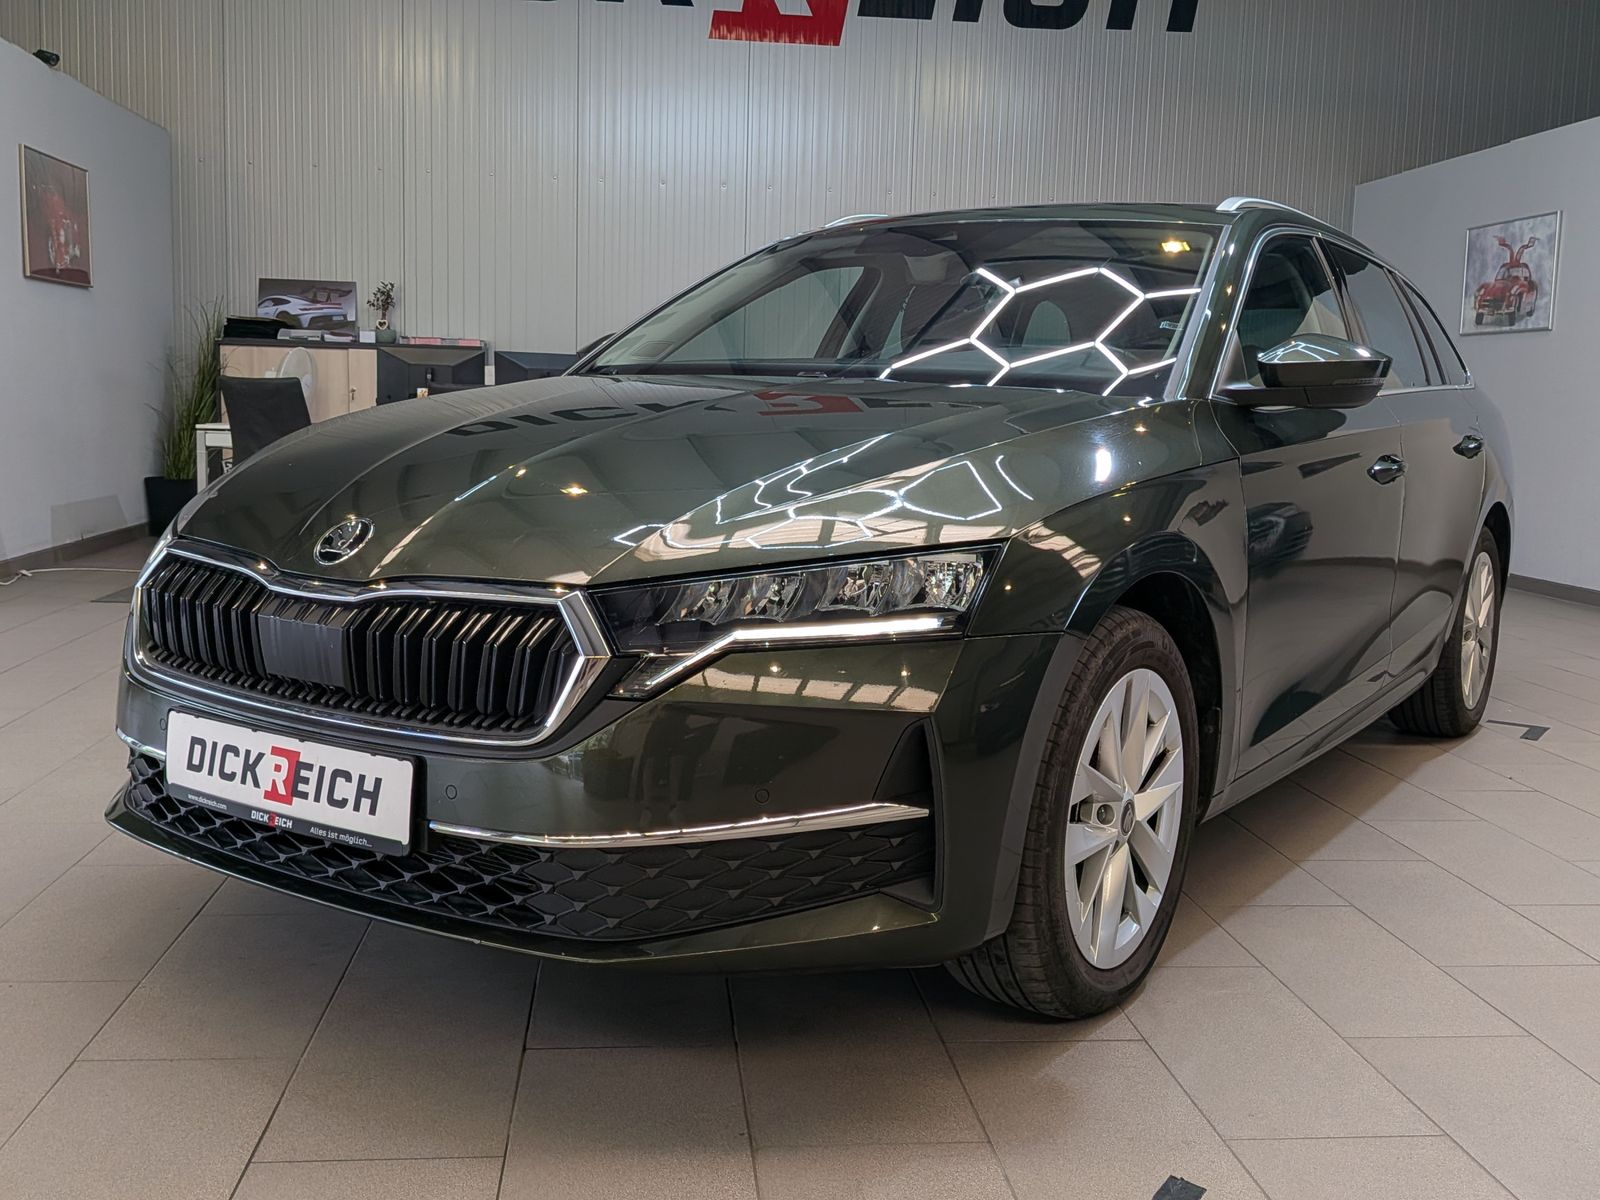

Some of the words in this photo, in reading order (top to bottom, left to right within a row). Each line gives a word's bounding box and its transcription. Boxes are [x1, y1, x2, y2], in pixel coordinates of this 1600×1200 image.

[186, 735, 383, 817] DICKREICH
[309, 827, 327, 838] Alles
[327, 830, 341, 840] ist
